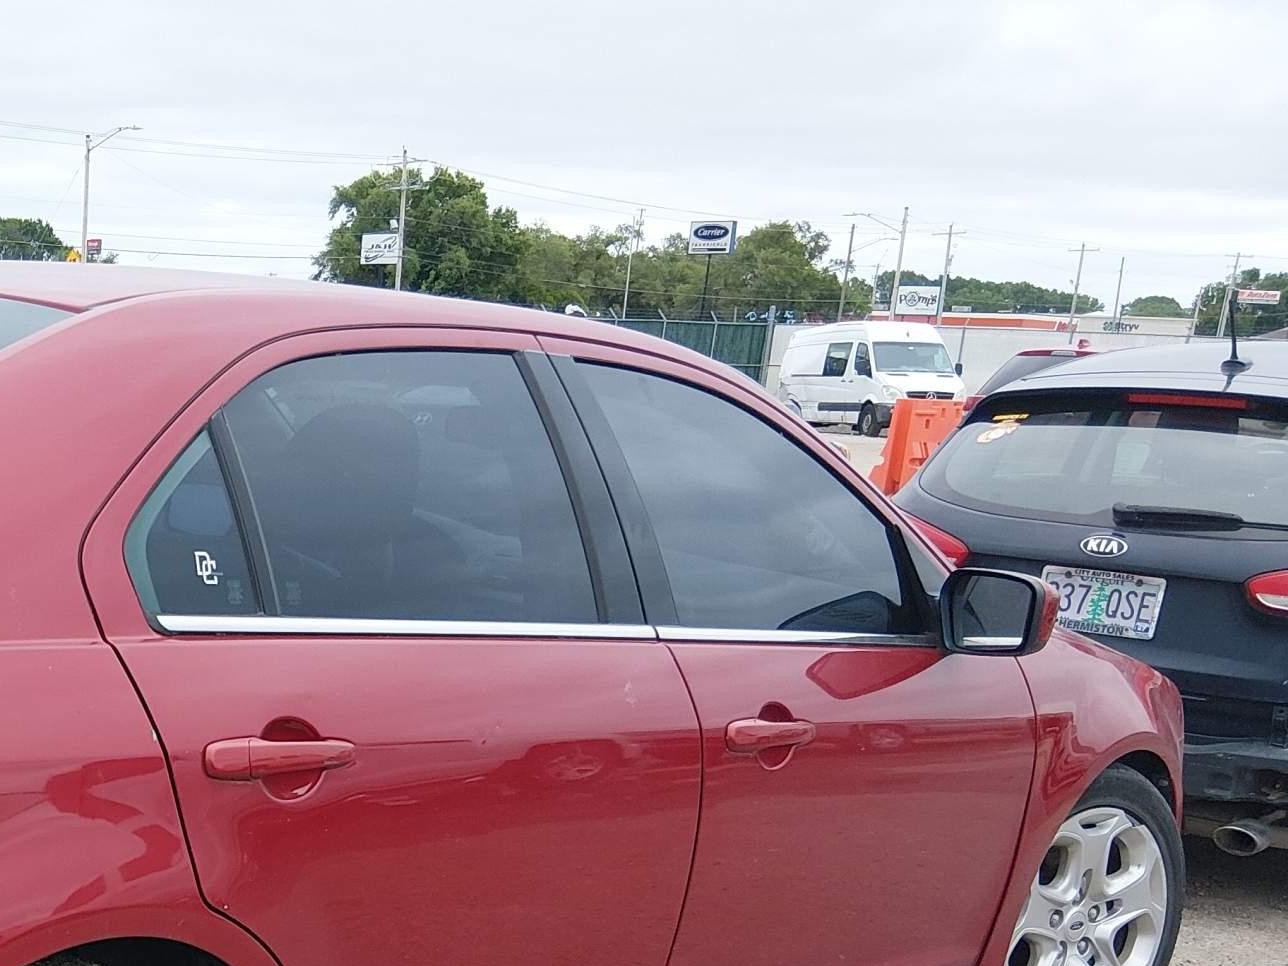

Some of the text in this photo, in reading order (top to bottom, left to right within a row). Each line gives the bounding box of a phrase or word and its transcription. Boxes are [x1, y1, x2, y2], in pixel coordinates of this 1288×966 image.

[697, 227, 726, 237] Carrier
[1086, 538, 1118, 554] KIA
[193, 551, 219, 585] DC
[1112, 573, 1135, 581] SALES
[1049, 581, 1157, 623] 37 QSE
[1059, 618, 1124, 635] HERMISTON
